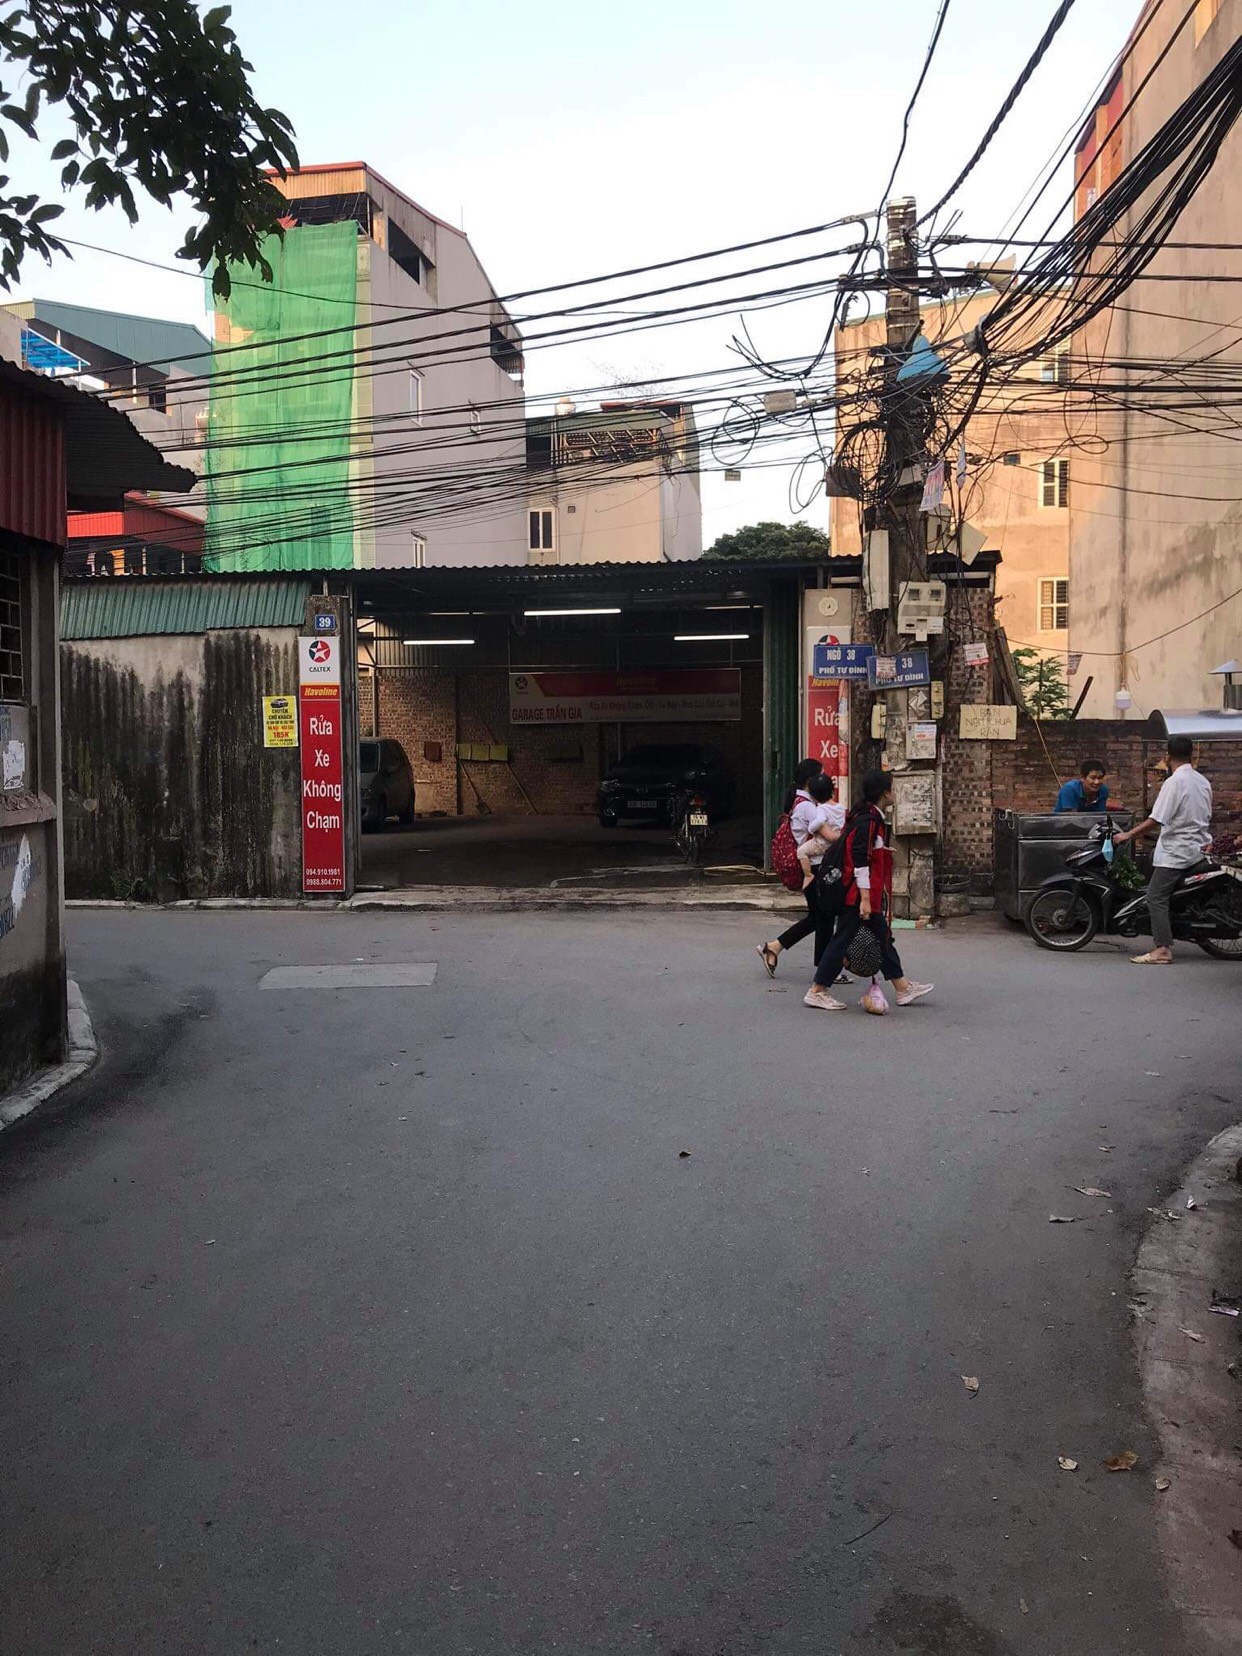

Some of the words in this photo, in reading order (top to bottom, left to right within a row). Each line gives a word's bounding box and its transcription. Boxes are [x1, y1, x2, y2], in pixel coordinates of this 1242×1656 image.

[318, 616, 331, 628] 39
[819, 665, 836, 674] PHỐ
[901, 657, 913, 669] 38
[904, 672, 924, 682] ĐÌNH
[304, 688, 338, 696] Havoline
[512, 707, 544, 720] GARAGE
[568, 707, 581, 719] GIA
[310, 715, 332, 735] Rửa
[820, 740, 838, 758] Xe
[315, 750, 330, 767] Xe
[304, 780, 342, 802] Không
[307, 811, 340, 833] Chạm
